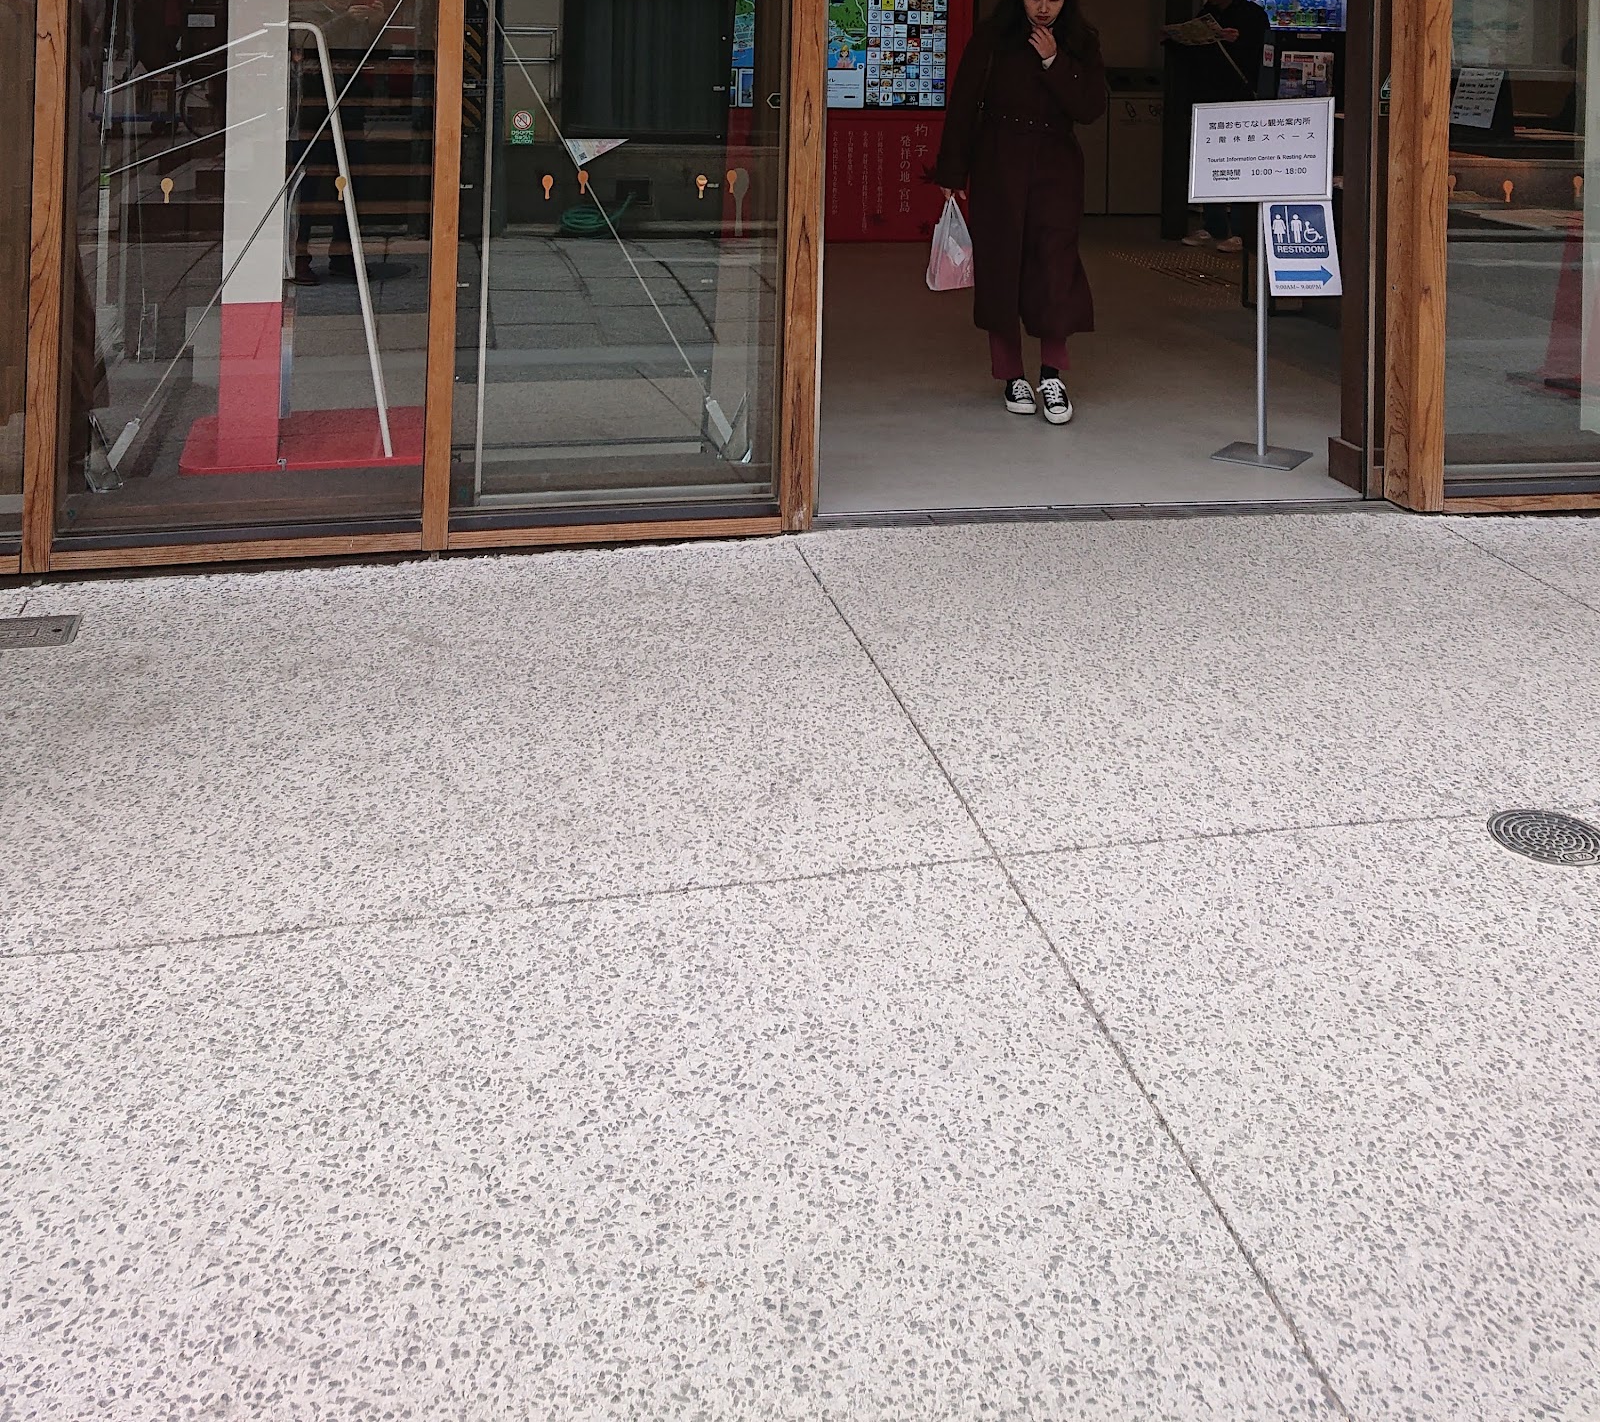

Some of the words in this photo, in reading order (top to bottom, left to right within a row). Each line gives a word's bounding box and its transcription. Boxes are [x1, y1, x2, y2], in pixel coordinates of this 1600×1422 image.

[1208, 116, 1311, 131] 宮島おもてなし観光案内所
[1251, 168, 1273, 176] 10:00
[1277, 245, 1326, 253] RESTROOM
